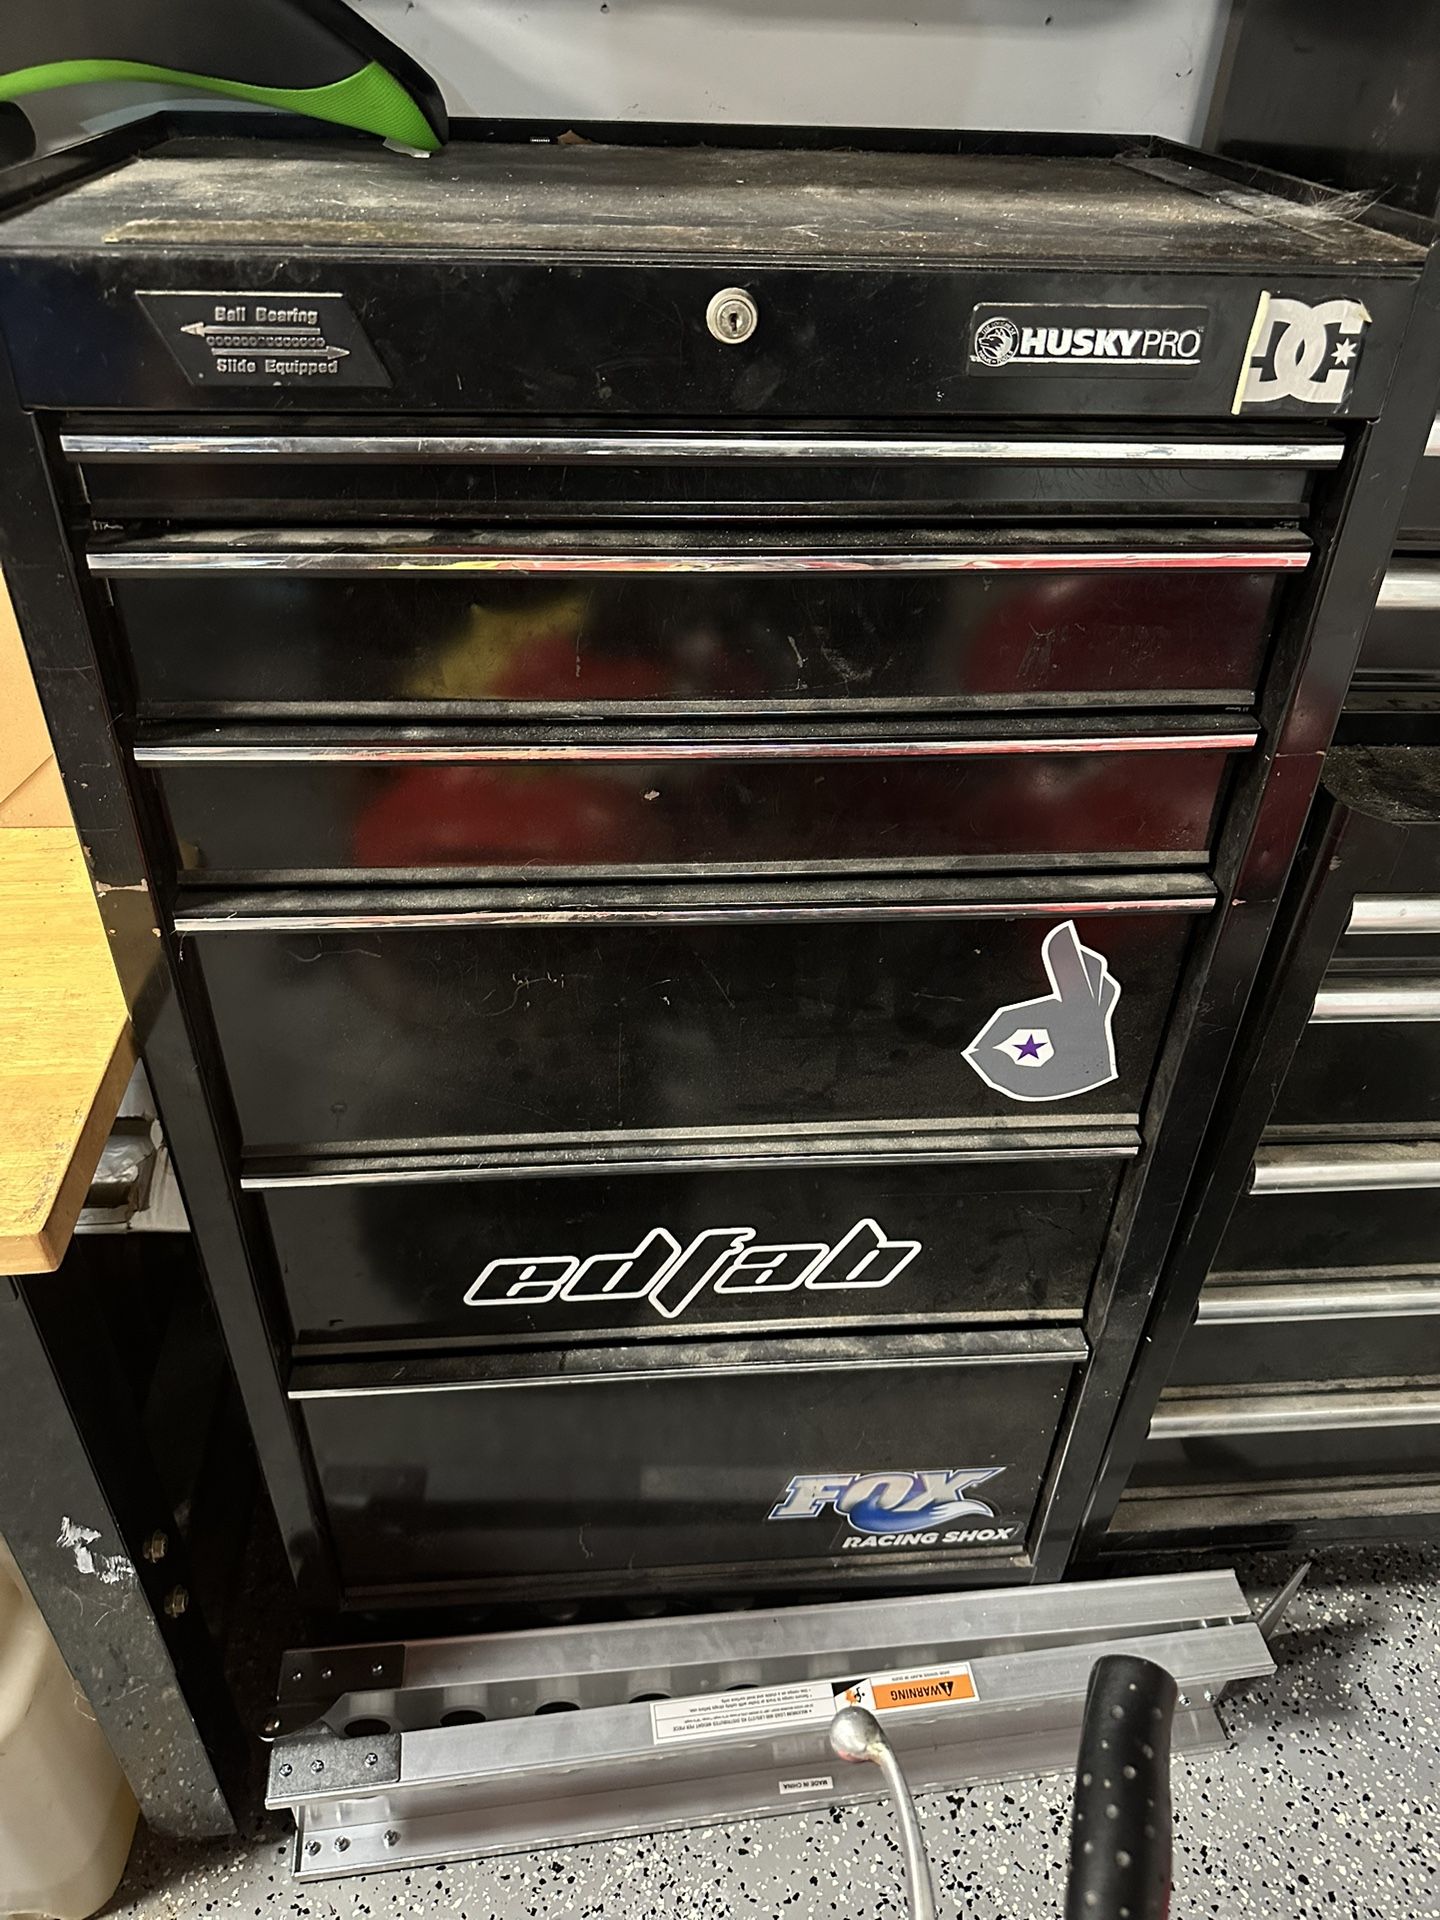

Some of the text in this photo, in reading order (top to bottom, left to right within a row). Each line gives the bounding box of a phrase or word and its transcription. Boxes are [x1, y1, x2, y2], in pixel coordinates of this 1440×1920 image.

[214, 306, 318, 325] Ball Bearing
[216, 358, 338, 374] Slide Equipped
[463, 1218, 921, 1318] edfab
[768, 1467, 1006, 1534] FOX
[842, 1527, 1014, 1549] RACING SHOX
[890, 1684, 942, 1701] WARNING
[810, 1780, 828, 1788] MADE
